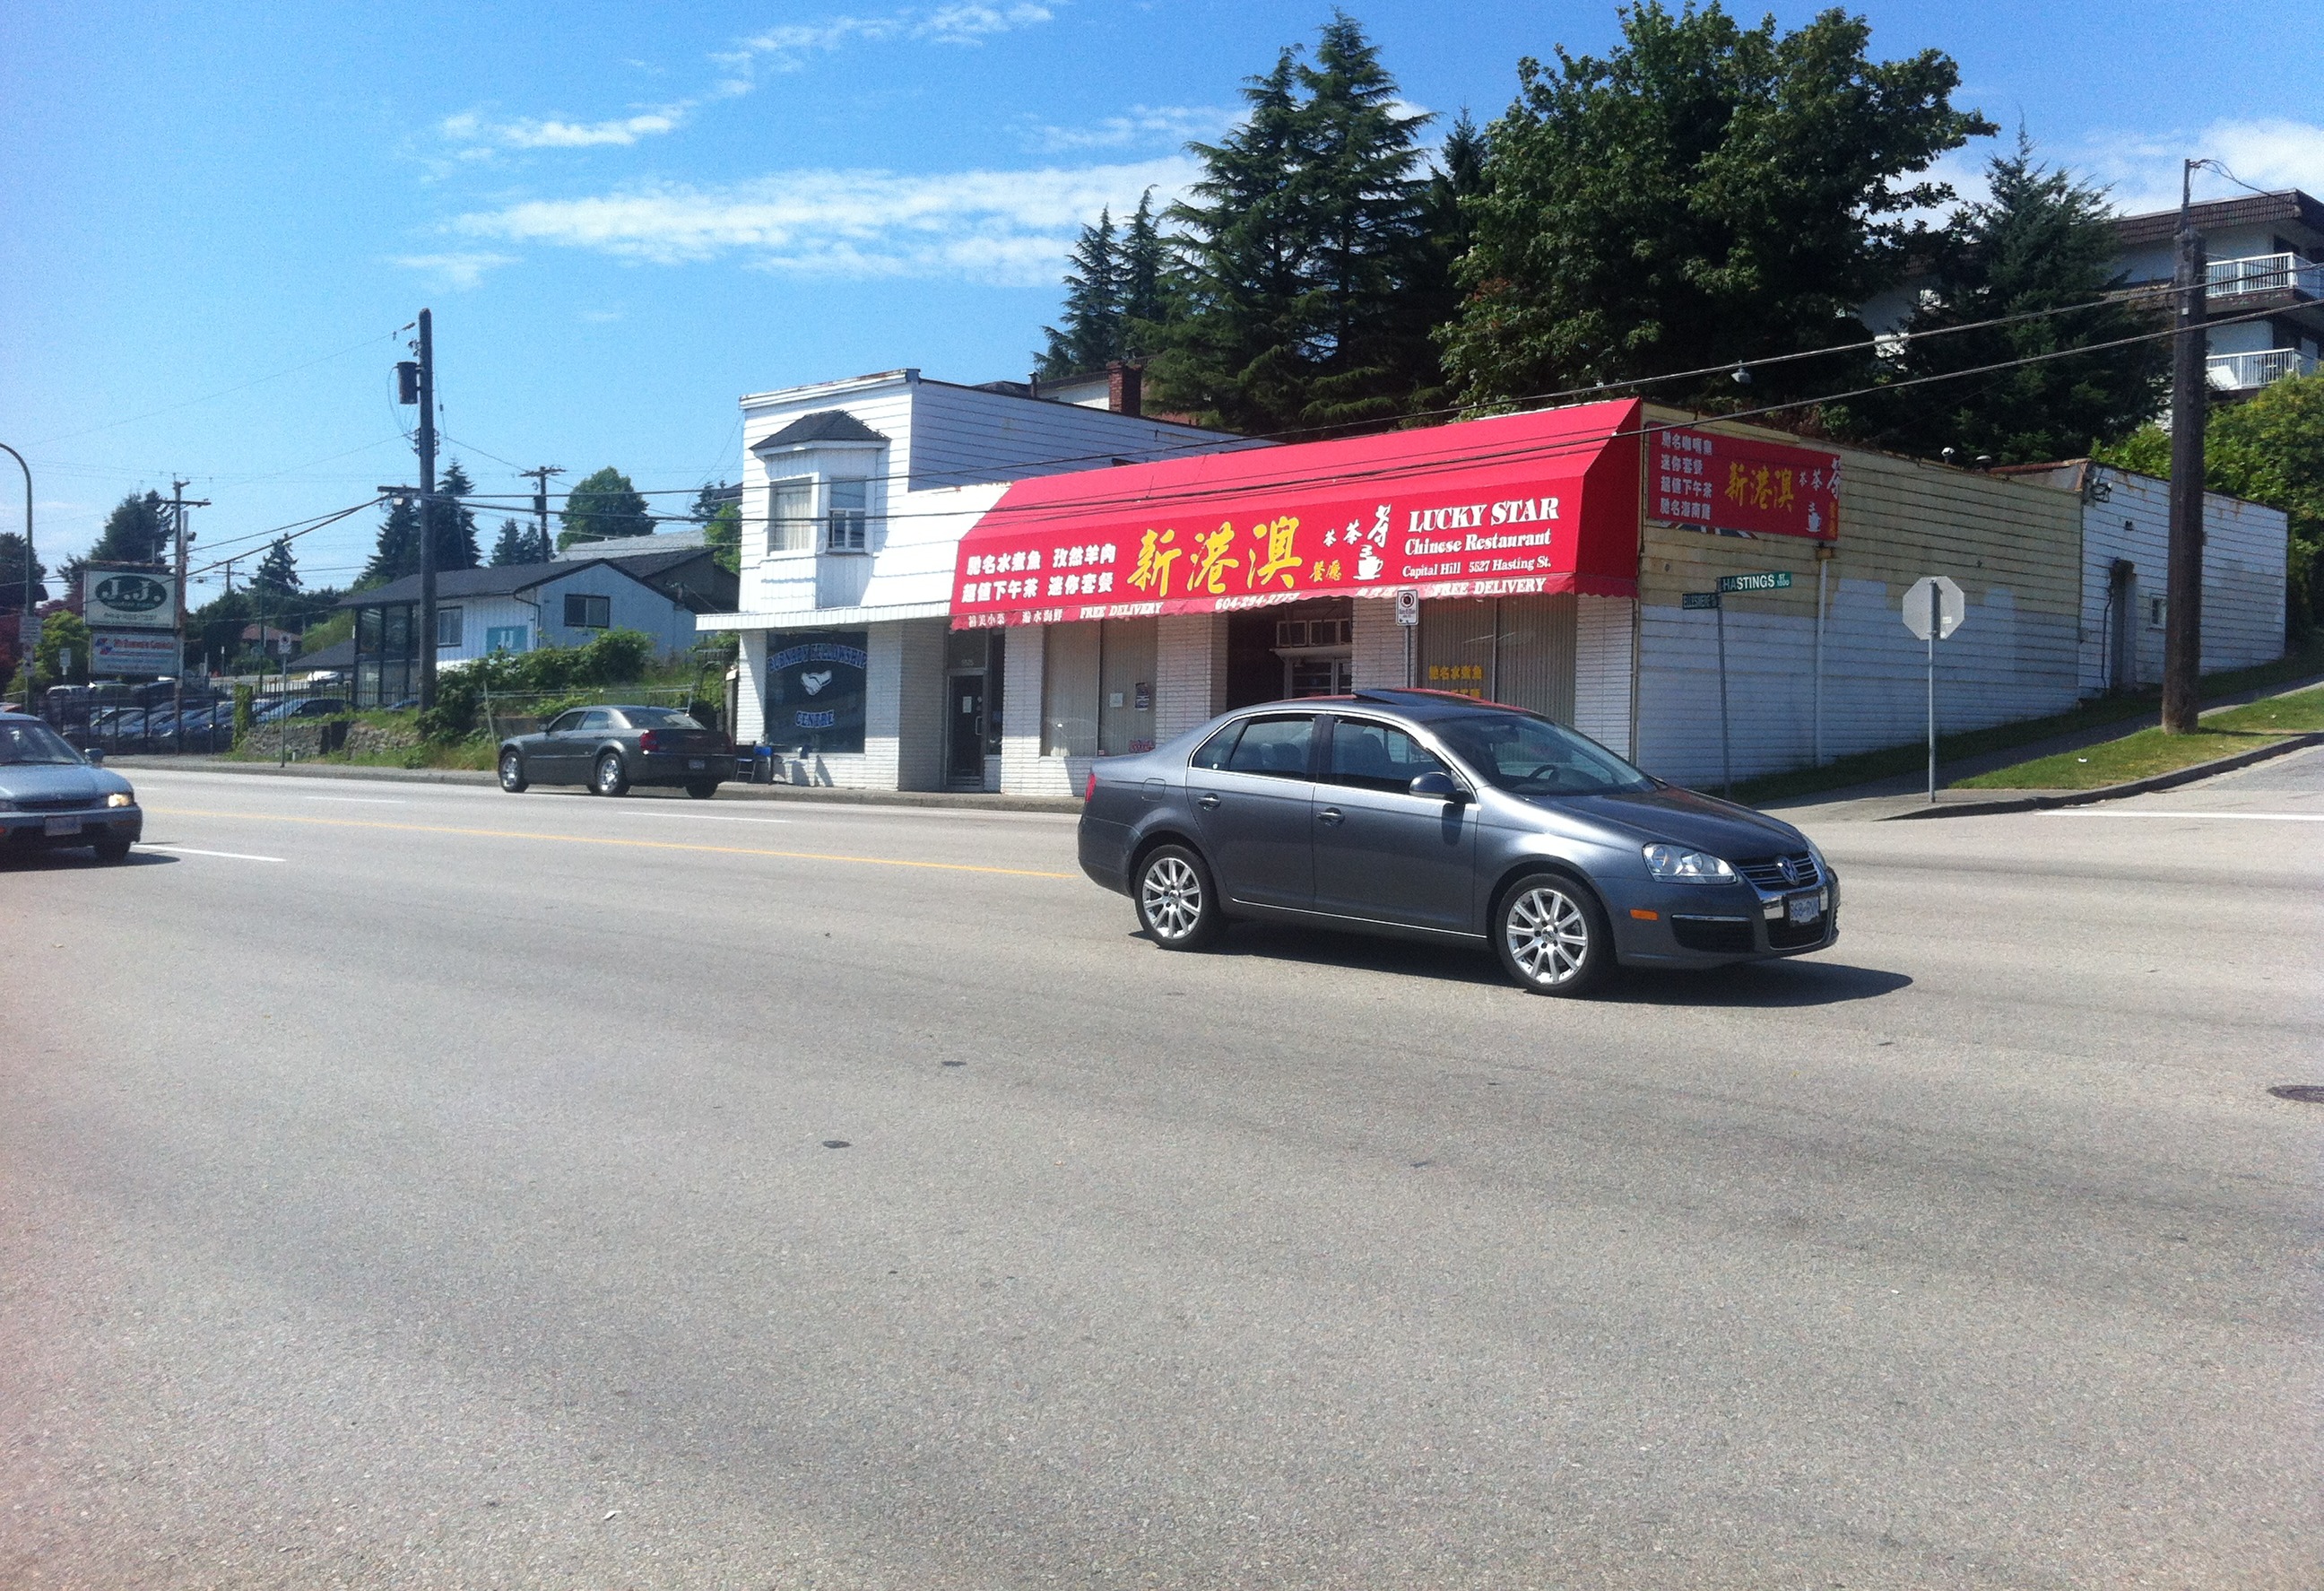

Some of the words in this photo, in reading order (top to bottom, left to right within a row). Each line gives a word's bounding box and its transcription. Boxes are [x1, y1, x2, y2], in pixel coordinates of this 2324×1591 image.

[1408, 504, 1487, 534] LUCKY
[1490, 497, 1560, 526] STAR
[1404, 535, 1461, 557] Chinese
[1464, 527, 1552, 552] Restaurant
[1127, 515, 1303, 597] 新港澳
[1402, 561, 1438, 578] Capital
[1440, 561, 1461, 575] Hill
[1492, 556, 1536, 574] Hasting
[961, 578, 1039, 604] 超值下午茶
[1047, 571, 1114, 597] 迷你套餐
[1432, 581, 1469, 596] FREE
[1473, 578, 1547, 594] DELIVERY
[1722, 574, 1775, 591] HASTINGS
[1080, 605, 1106, 619] FREE
[1108, 602, 1164, 617] DELIVERY
